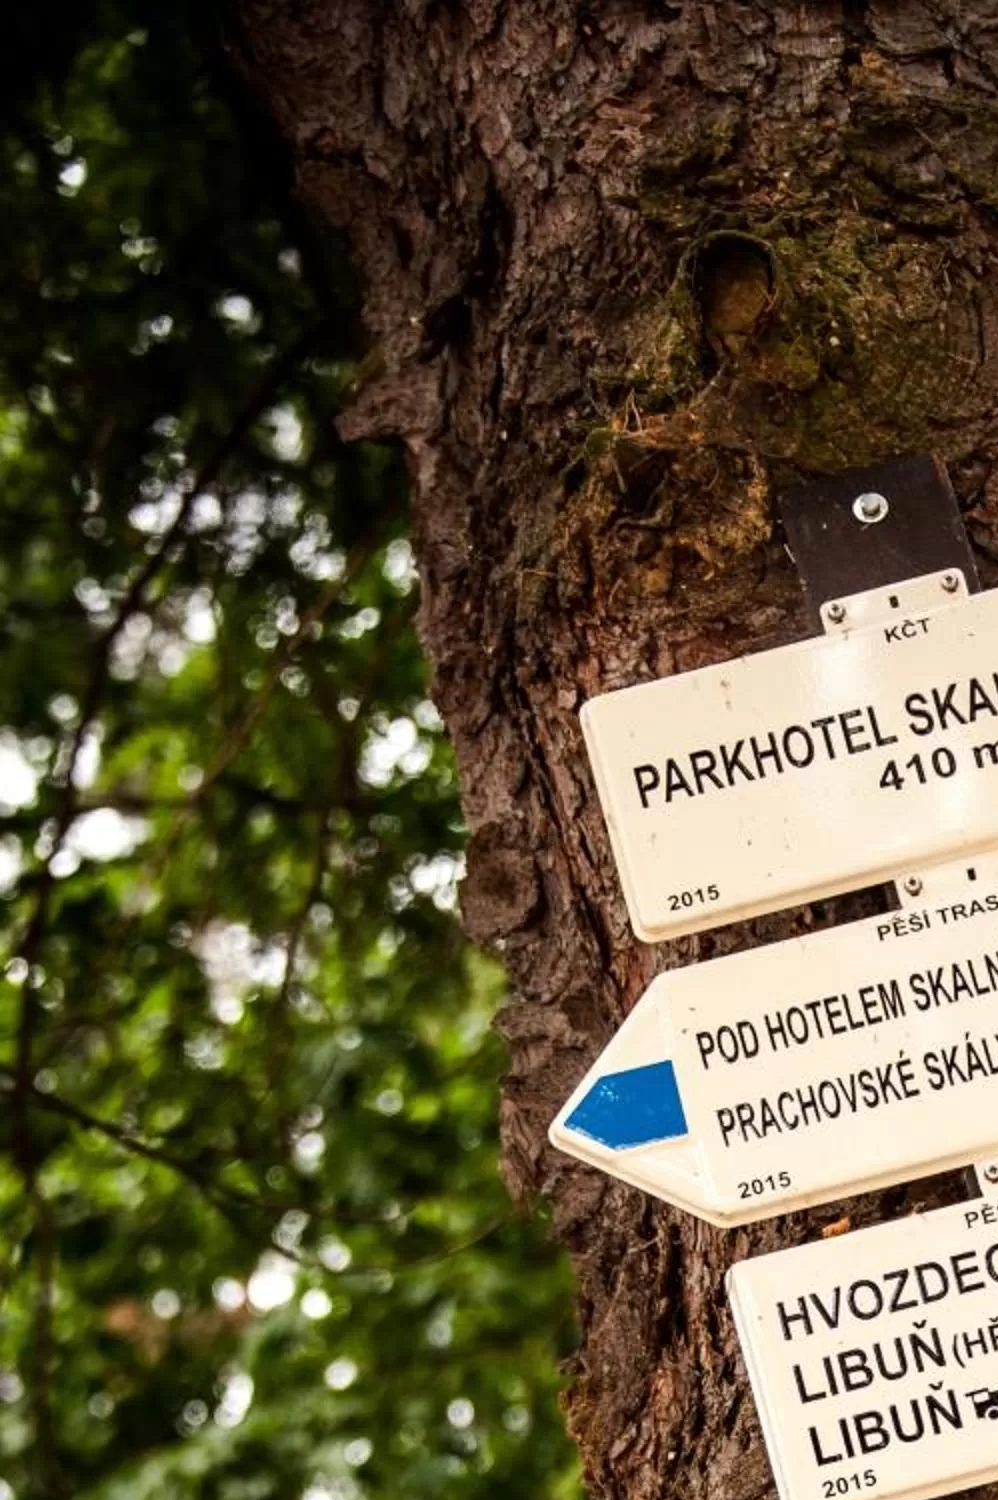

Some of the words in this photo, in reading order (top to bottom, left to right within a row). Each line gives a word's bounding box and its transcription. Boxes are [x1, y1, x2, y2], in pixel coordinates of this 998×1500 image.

[883, 617, 930, 644] KČT
[632, 705, 899, 809] PARKHOTEL
[879, 746, 957, 791] 410
[667, 884, 720, 911] 2015
[876, 910, 931, 942] PĚŠÍ
[695, 1020, 760, 1070] POD
[763, 979, 907, 1052] HOTELEM
[716, 1049, 921, 1148] PRACHOVSKÉ
[737, 1171, 791, 1200] 2015
[792, 1319, 947, 1405] LIBUŇ
[807, 1380, 964, 1467] LIBUŇ
[822, 1469, 877, 1499] 2015
